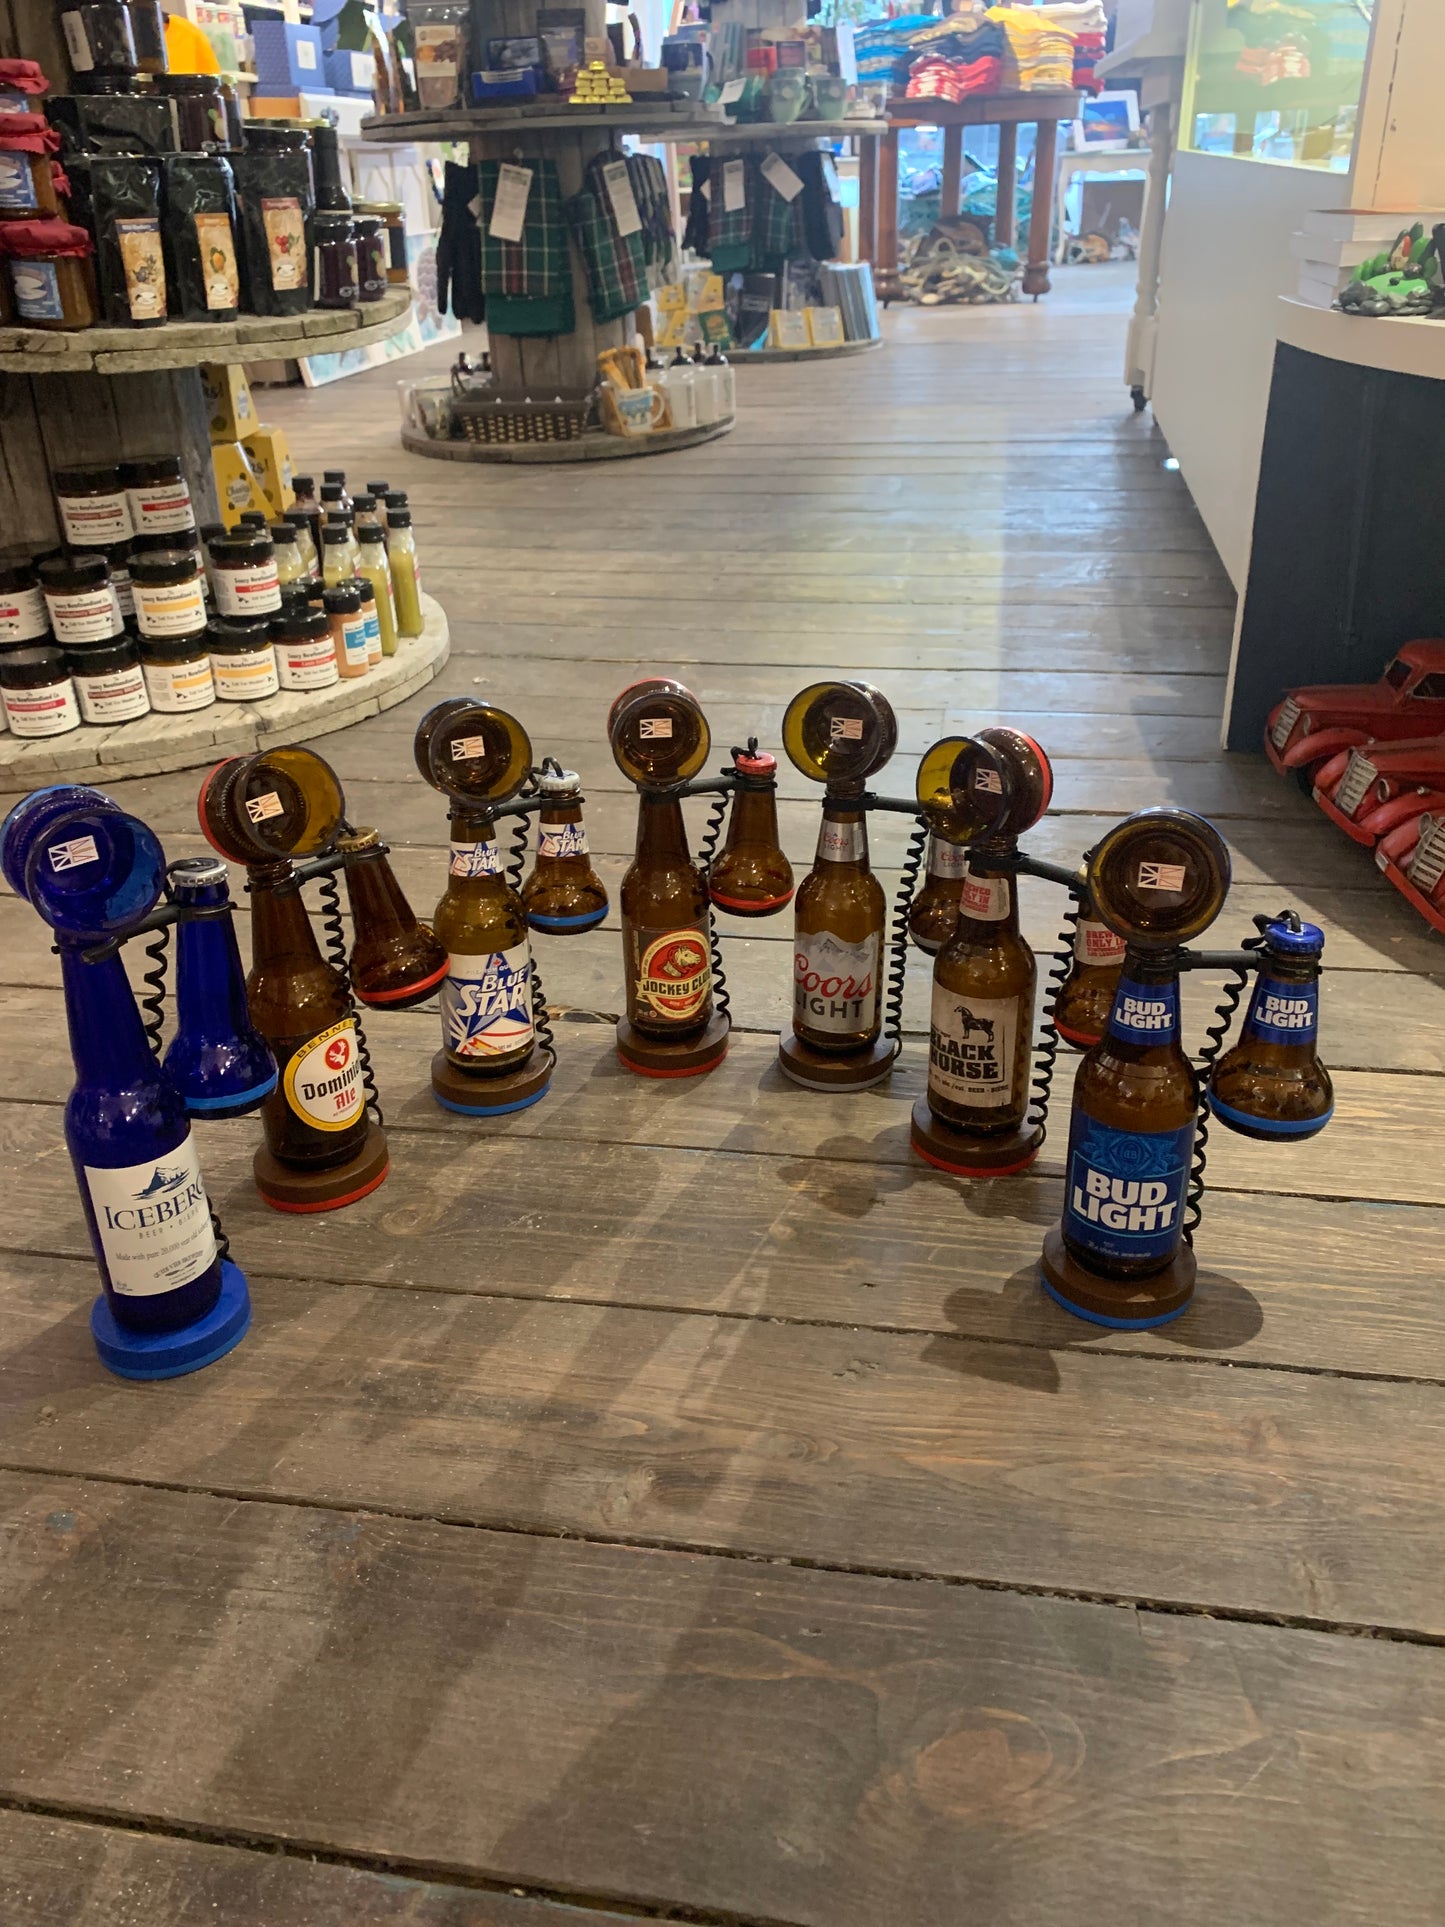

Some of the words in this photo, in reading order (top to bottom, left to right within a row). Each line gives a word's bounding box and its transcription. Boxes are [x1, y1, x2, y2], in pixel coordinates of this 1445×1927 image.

[547, 836, 585, 854] STAR
[562, 830, 585, 840] BLUE
[461, 853, 499, 873] STAR
[474, 847, 498, 858] BLUE
[1085, 930, 1113, 939] BREW
[482, 968, 525, 993] BLUE
[642, 979, 690, 996] JOCKEY
[794, 953, 873, 1000] Coors
[455, 982, 527, 1017] STAR
[795, 985, 865, 1019] LIGHT
[1123, 997, 1166, 1016] BUD
[1265, 995, 1309, 1014] BUD
[1115, 1007, 1173, 1030] LIGHT
[1255, 1006, 1313, 1028] LIGHT
[930, 1030, 995, 1061] BLACK
[930, 1049, 998, 1079] HORSE
[301, 1059, 360, 1101] Domini
[333, 1087, 356, 1111] Ale
[1086, 1168, 1168, 1207] BUD
[1073, 1185, 1178, 1231] LIGHT
[139, 1228, 163, 1240] BEER
[115, 1252, 131, 1261] Made
[132, 1252, 146, 1260] with
[146, 1251, 160, 1260] pure
